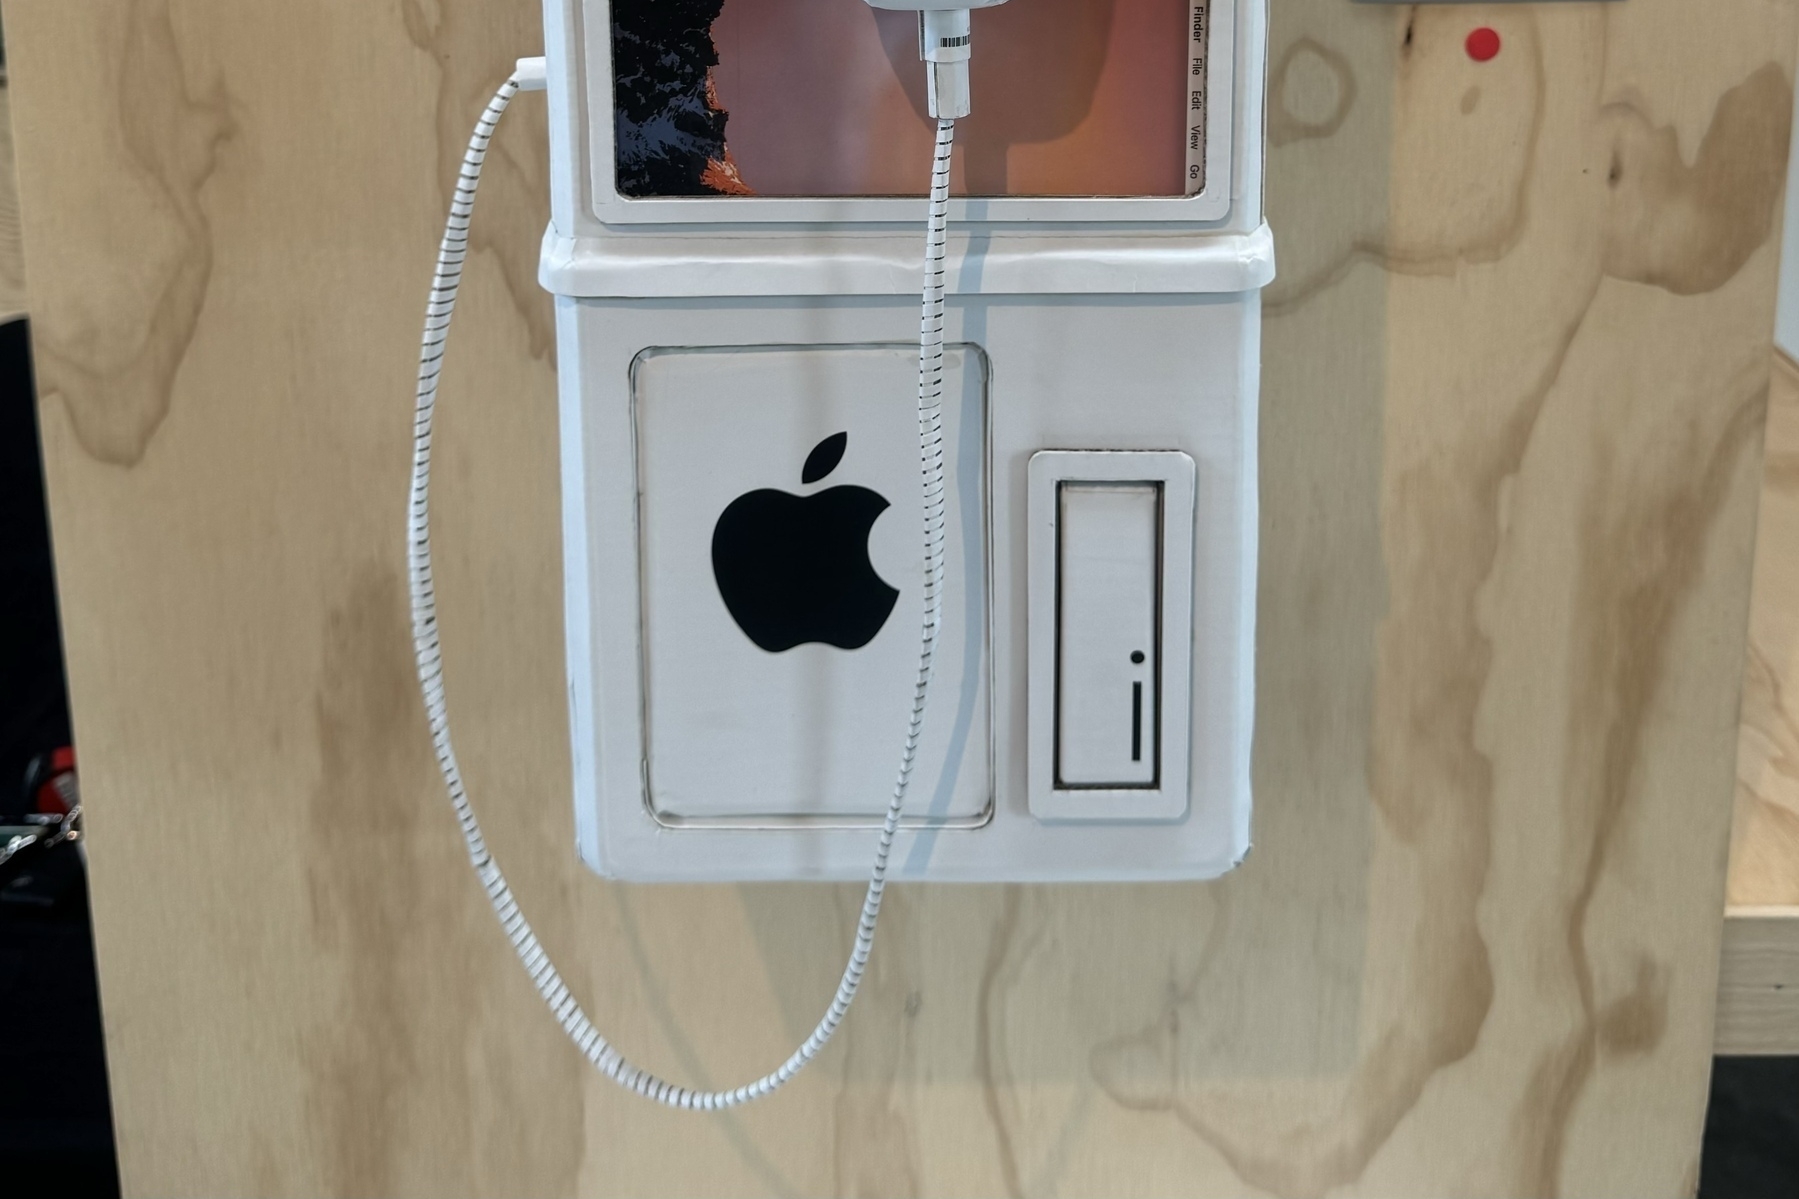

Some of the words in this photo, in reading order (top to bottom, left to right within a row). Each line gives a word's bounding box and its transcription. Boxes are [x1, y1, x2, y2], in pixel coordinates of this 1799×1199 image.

[1192, 6, 1204, 43] Finder
[1191, 57, 1202, 76] File
[1190, 90, 1202, 111] Edit
[1190, 124, 1201, 150] View
[1189, 164, 1200, 180] Go
